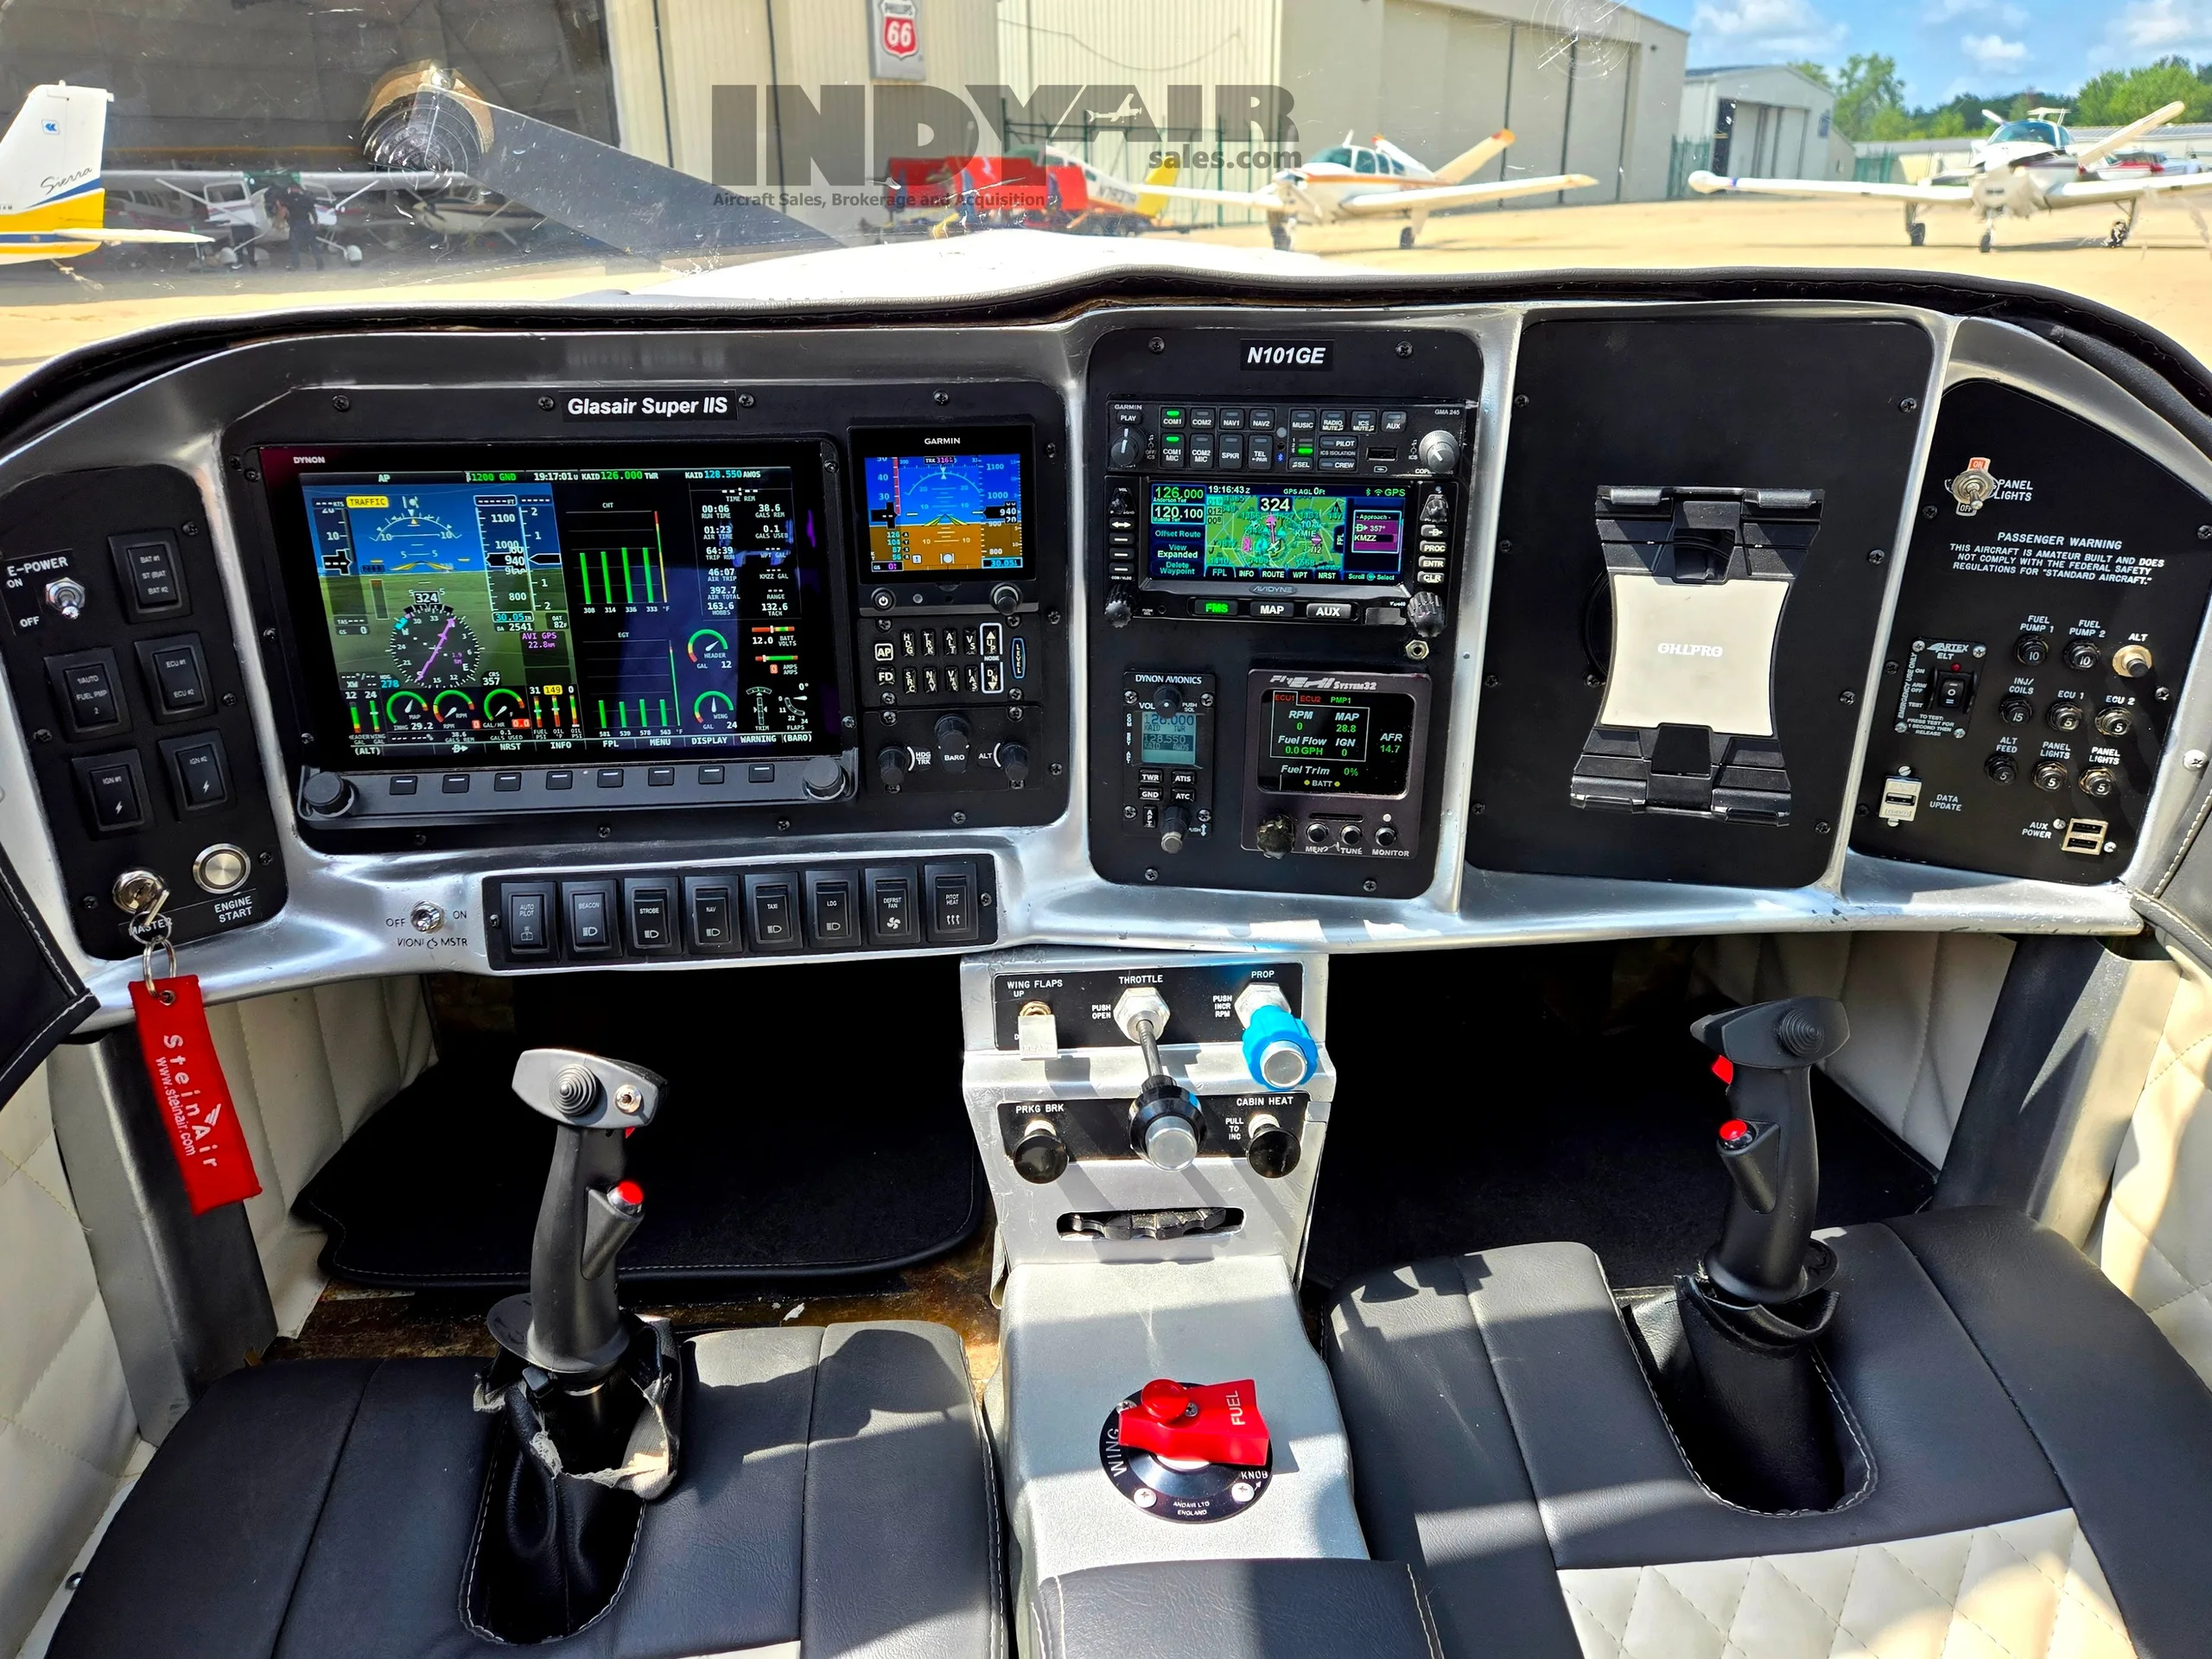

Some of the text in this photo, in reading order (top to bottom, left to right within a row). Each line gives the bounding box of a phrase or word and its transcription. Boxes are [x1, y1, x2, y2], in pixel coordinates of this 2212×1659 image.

[887, 21, 912, 47] 66
[41, 168, 92, 195] Sierra
[1248, 347, 1325, 364] N101GE
[568, 397, 637, 415] Glasair
[642, 397, 699, 417] Super
[601, 471, 643, 480] 126.000
[685, 471, 703, 480] KAID
[704, 469, 741, 479] 128.550
[1999, 480, 2033, 490] PANEL
[1155, 486, 1204, 499] 126.000
[1994, 492, 2031, 501] LIGHTS
[1261, 499, 1290, 512] 324
[1154, 506, 1203, 518] 120.100
[1997, 532, 2122, 550] PASSENGER WARNING
[1949, 543, 1972, 552] THIS
[1974, 545, 2019, 556] AIRCRAFT
[2036, 550, 2081, 561] AMATEUR
[2084, 552, 2113, 563] BUILT
[2115, 556, 2136, 565] AND
[2139, 557, 2164, 567] DOES
[7, 556, 68, 577] E-POWER
[1953, 562, 2017, 575] REGULATIONS
[2019, 567, 2039, 576] FOR
[1958, 553, 2152, 575] NOT COMPLY WITH THE FEDERAL SAFETY
[7, 578, 22, 588] ON
[1253, 585, 1293, 594] AVIDYNE
[416, 594, 437, 602] 324
[1205, 603, 1229, 613] FMS
[1260, 605, 1284, 614] MAP
[1316, 607, 1340, 616] AUX
[19, 616, 40, 627] OFF
[2028, 615, 2050, 624] FUEL
[2020, 623, 2054, 633] PUMP 1
[2128, 633, 2148, 642] ALT
[878, 648, 892, 657] AP
[1938, 644, 1969, 652] ARTEX
[879, 672, 893, 681] FD
[1166, 676, 1202, 684] AVIONICS
[2009, 685, 2034, 695] COILS
[2057, 690, 2076, 699] ECU
[1275, 694, 1294, 702] ECU1
[2106, 695, 2135, 705] ECU 2
[1289, 710, 1359, 721] RPM MAP
[1336, 724, 1357, 733] 28.8
[1278, 735, 1327, 746] Fuel Flow
[1336, 738, 1356, 747] IGN
[1380, 734, 1402, 742] AFR
[1380, 745, 1400, 753] 14.7
[1996, 744, 2018, 753] FEED
[2043, 741, 2071, 752] PANEL
[2040, 749, 2070, 760] LIGHTS
[1281, 765, 1358, 777] Fuel Trim 0%
[1936, 794, 1959, 803] DATA
[1929, 802, 1962, 811] UPDATE
[2029, 822, 2048, 830] AUX
[2022, 829, 2052, 839] POWER
[214, 896, 252, 912] ENGINE
[219, 907, 252, 923] START
[1250, 969, 1274, 979] PROP
[1007, 978, 1063, 989] WING FLAPS
[1118, 974, 1164, 985] THROTTLE
[1212, 995, 1233, 1004] PUSH
[1091, 1004, 1111, 1013] PUSH
[1091, 1011, 1111, 1020] OPEN
[156, 1056, 196, 1157] www.steinair.com
[1236, 1096, 1294, 1107] CABIN HEAT
[1015, 1103, 1065, 1115] PRKG BRK
[1225, 1118, 1244, 1127] PULL
[1229, 1125, 1240, 1134] TO
[1228, 1132, 1242, 1141] INC
[1225, 1389, 1246, 1426] FUEL
[1106, 1427, 1128, 1478] WING
[1241, 1470, 1268, 1480] KNOB
